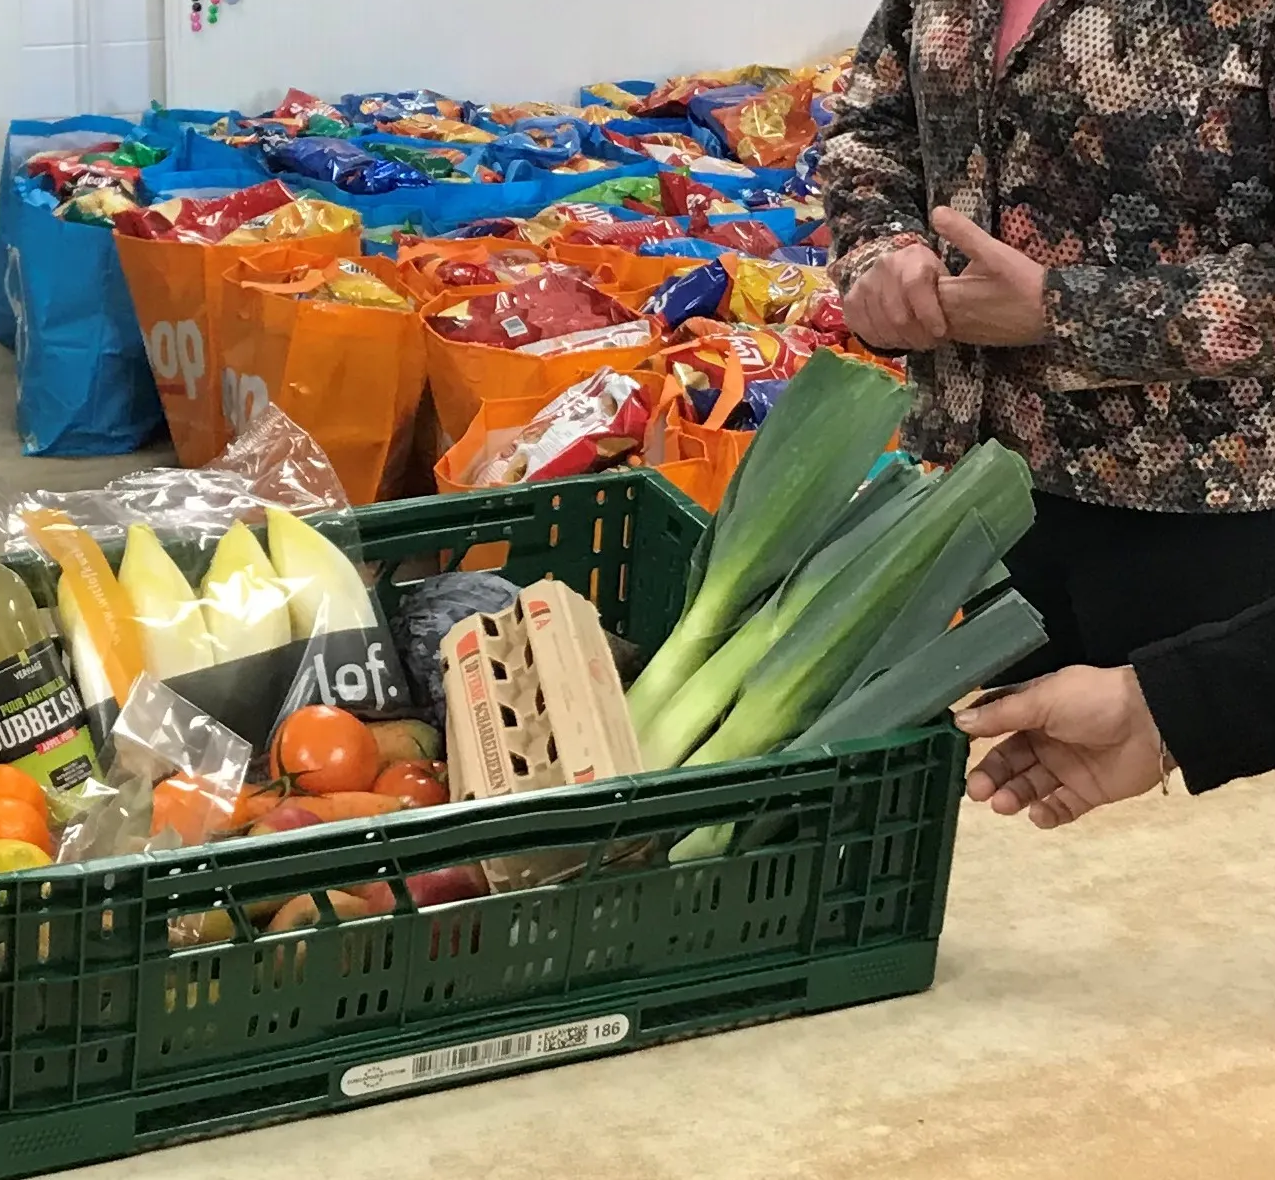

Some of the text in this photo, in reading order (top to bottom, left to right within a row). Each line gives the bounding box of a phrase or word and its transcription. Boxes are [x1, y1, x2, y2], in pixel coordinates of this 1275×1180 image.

[143, 319, 205, 400] op
[313, 642, 398, 711] lof.
[0, 700, 25, 717] PUUR
[592, 1021, 621, 1039] 186
